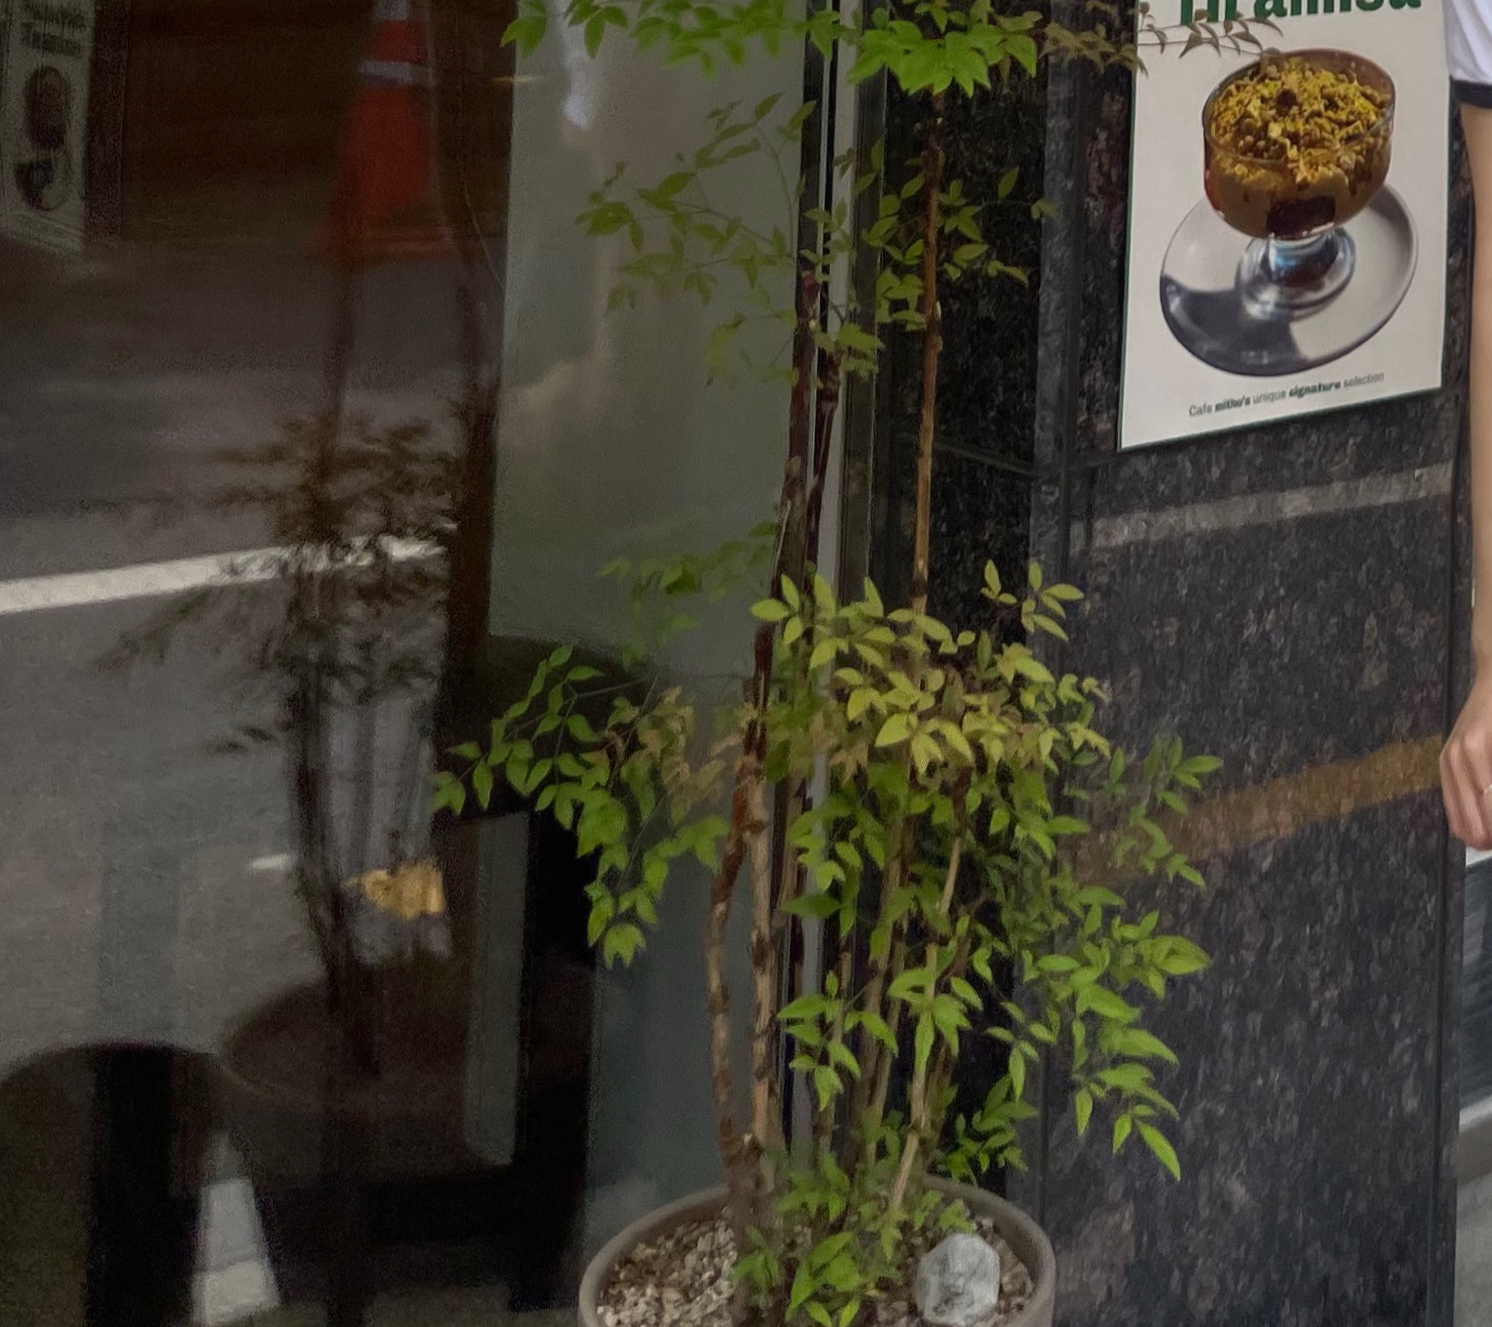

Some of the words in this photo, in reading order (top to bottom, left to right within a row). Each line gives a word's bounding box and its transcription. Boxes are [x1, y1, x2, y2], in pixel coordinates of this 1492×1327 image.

[1188, 404, 1212, 417] Cafe
[1214, 395, 1251, 413] mitho's
[1252, 389, 1287, 404] unique
[1288, 380, 1341, 398] signature
[1343, 372, 1385, 388] selection
